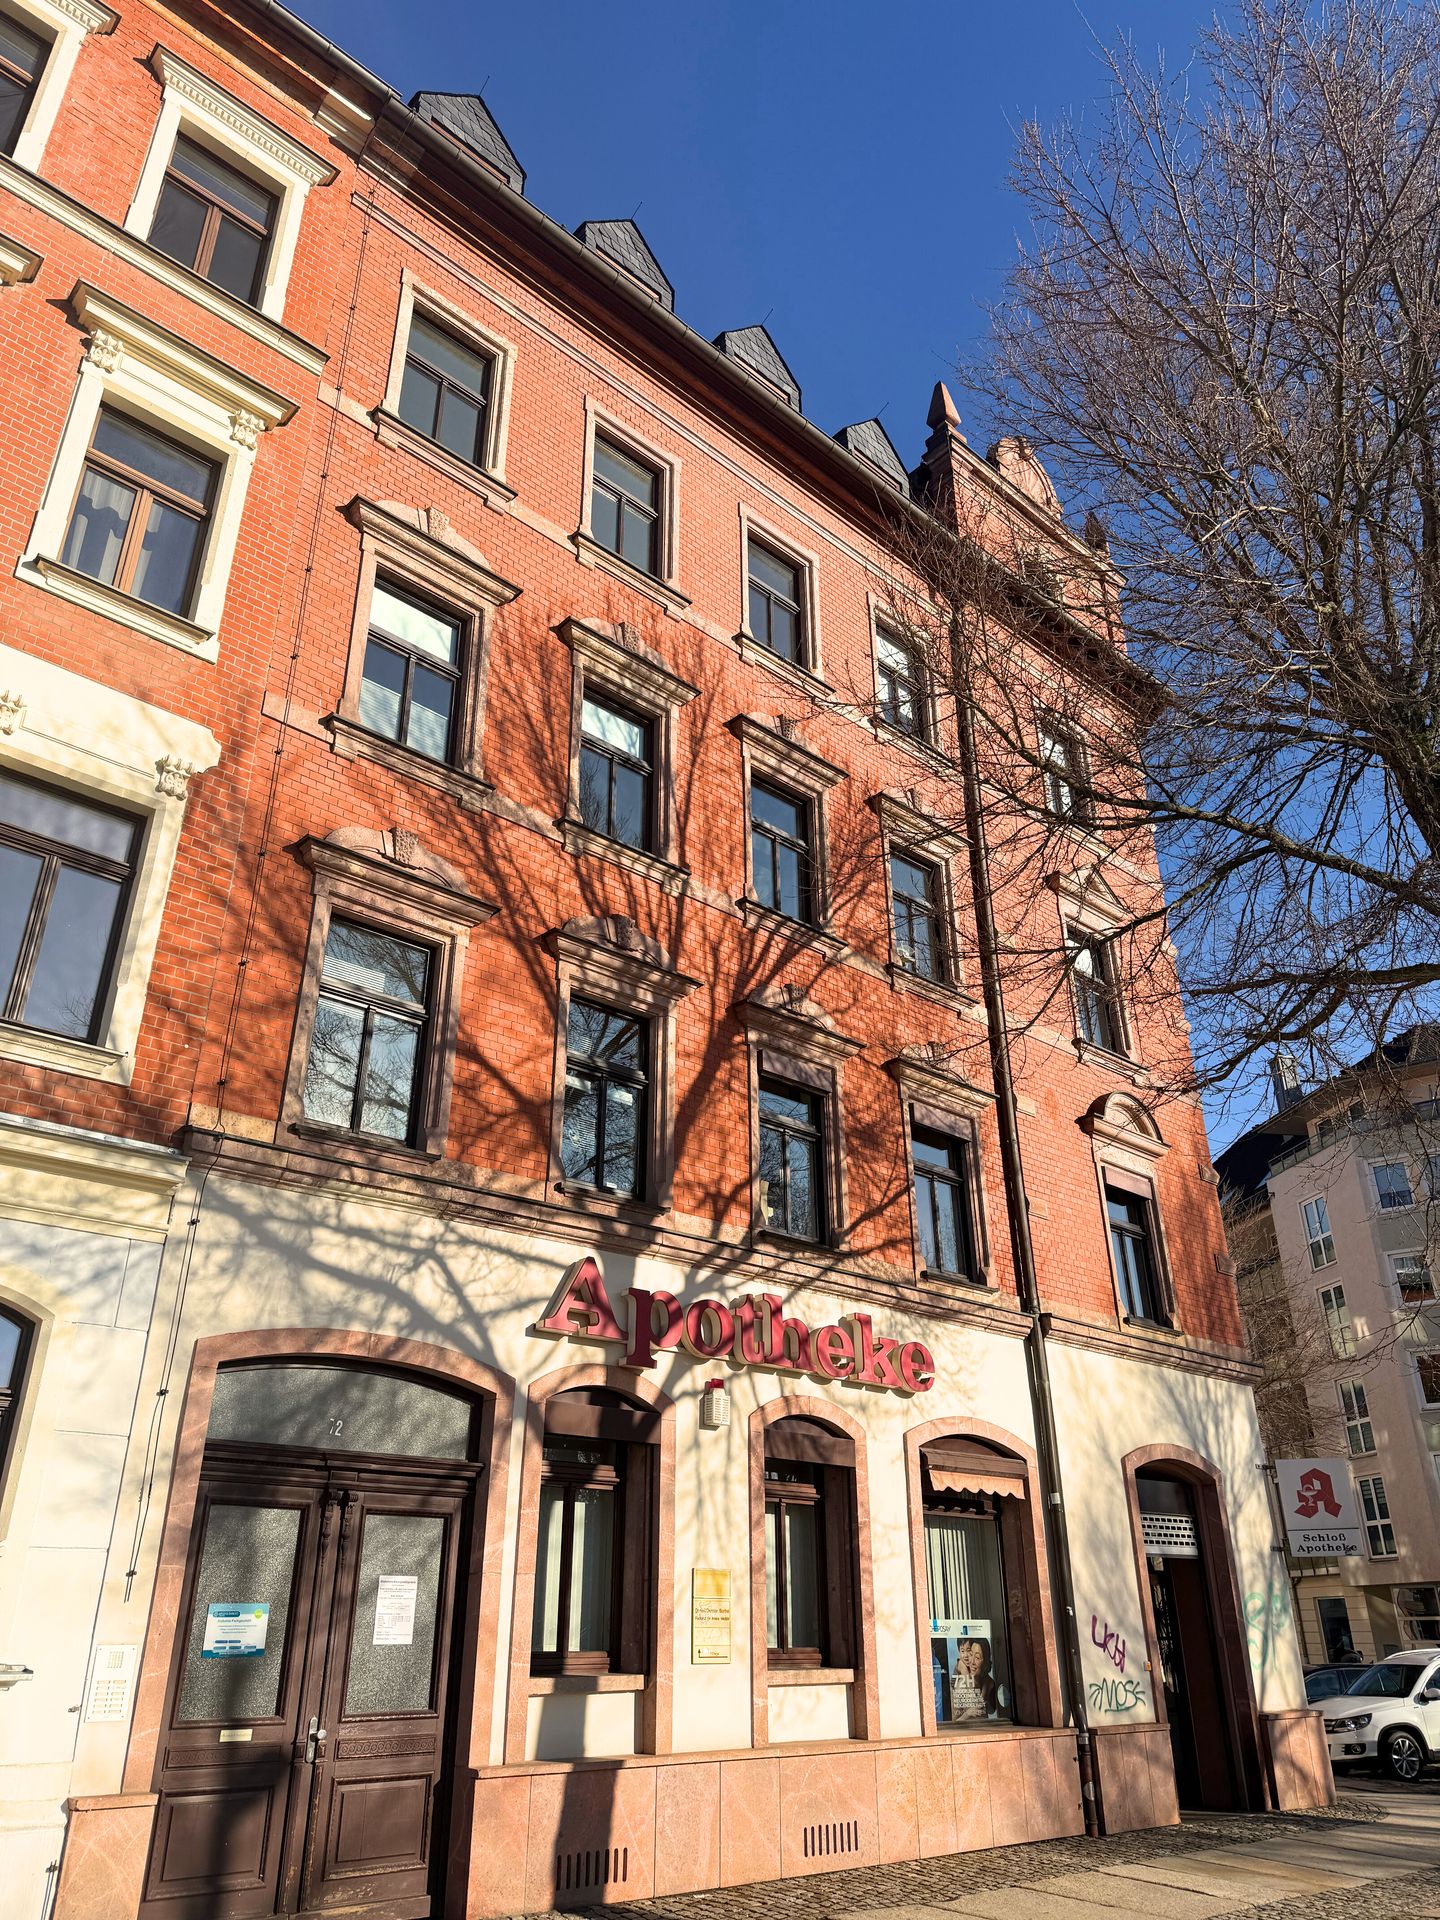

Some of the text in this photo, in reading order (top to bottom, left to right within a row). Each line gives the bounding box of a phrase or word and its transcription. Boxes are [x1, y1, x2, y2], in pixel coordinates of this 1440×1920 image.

[536, 1256, 935, 1393] Apotheke
[329, 1418, 343, 1436] 72
[1302, 1533, 1347, 1542] Schloß
[1297, 1544, 1358, 1554] Apotheke
[951, 1674, 975, 1688] 72H
